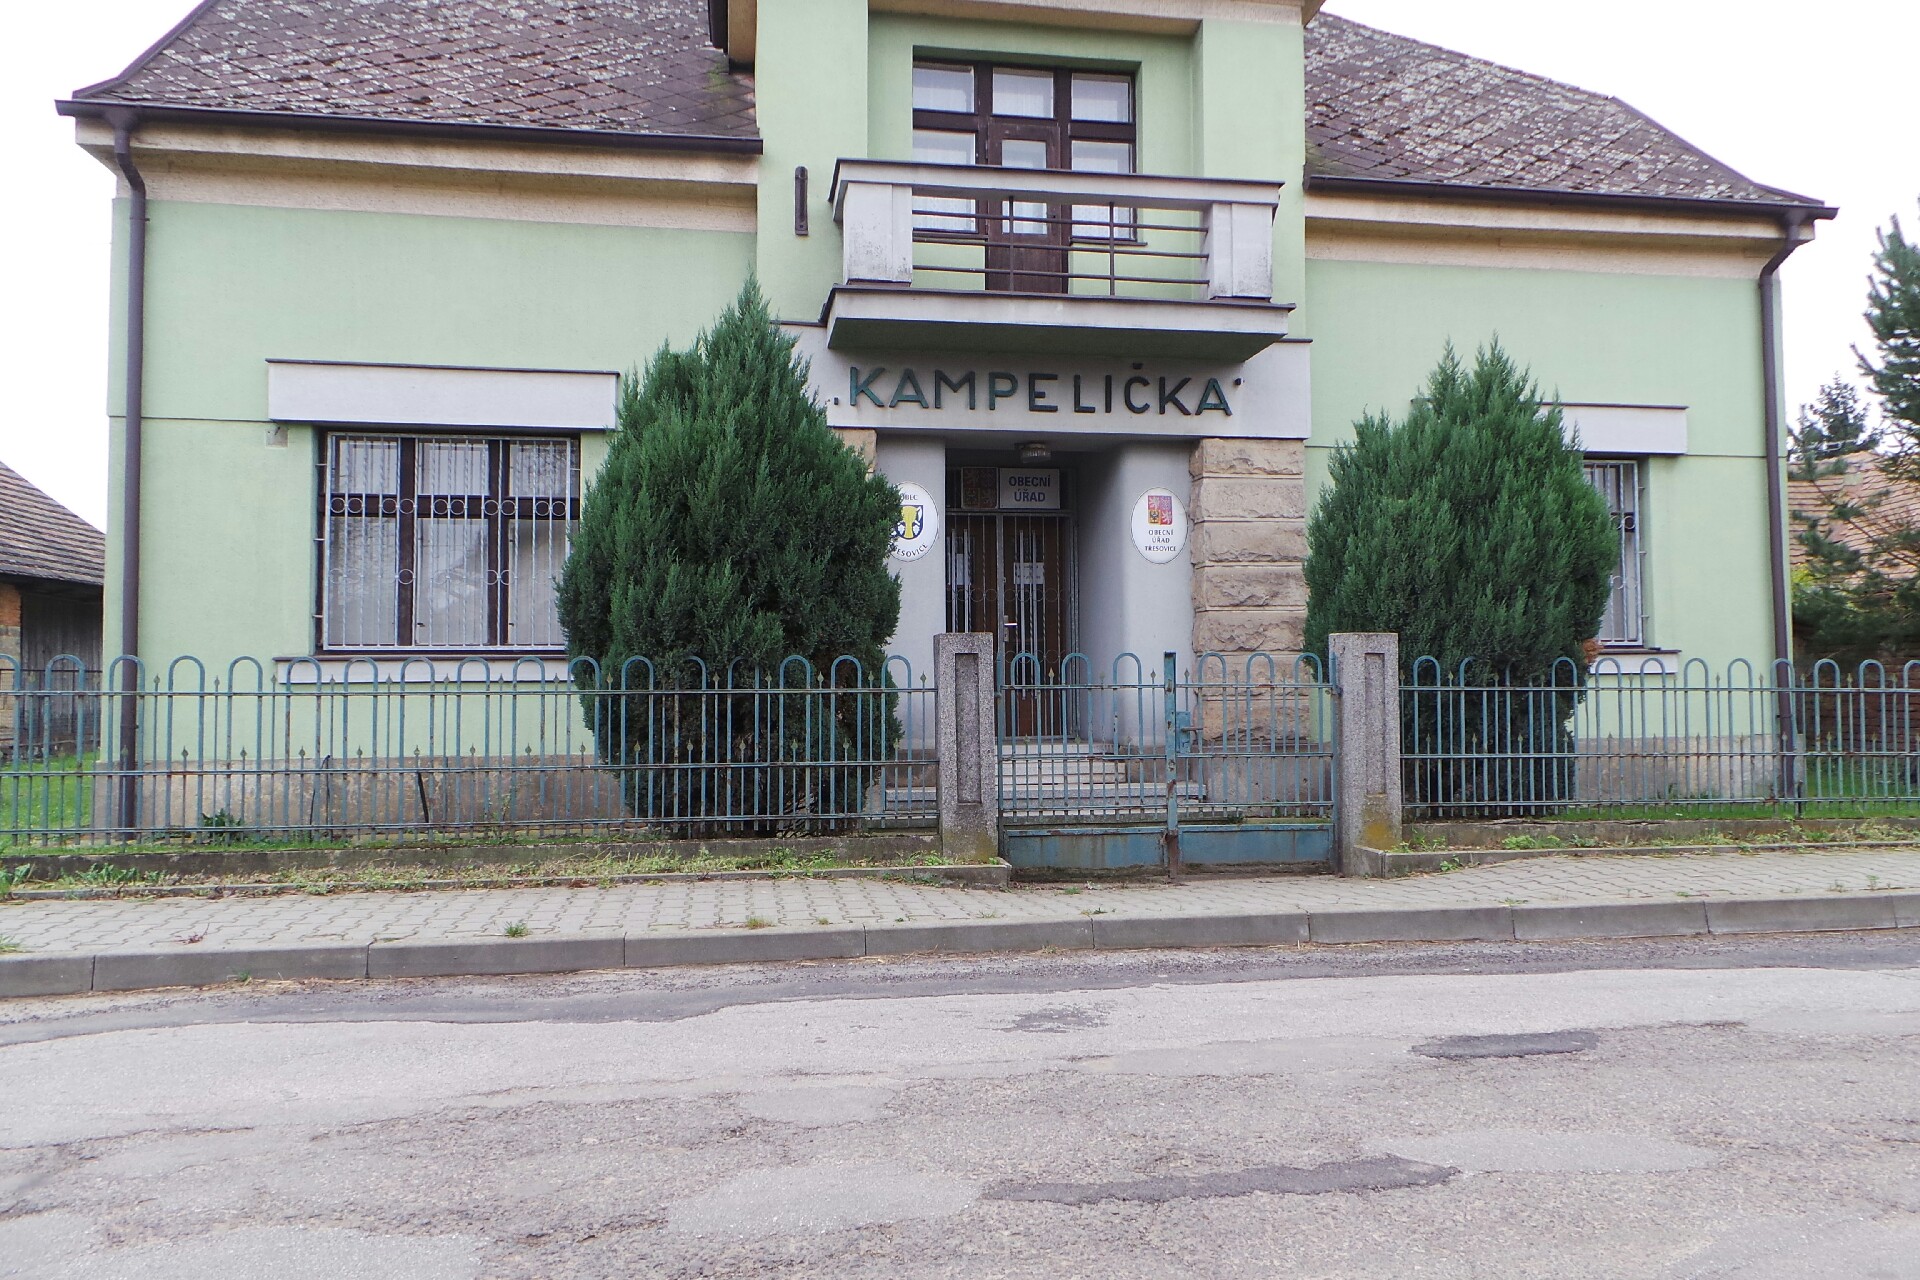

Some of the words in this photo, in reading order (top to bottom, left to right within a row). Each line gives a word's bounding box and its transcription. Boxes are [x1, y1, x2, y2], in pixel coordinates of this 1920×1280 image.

[849, 362, 1232, 416] KAMPELIČKA
[1008, 474, 1051, 488] OBECNÍ
[1014, 489, 1046, 503] ÚŘAD
[893, 543, 928, 557] ESOVICE
